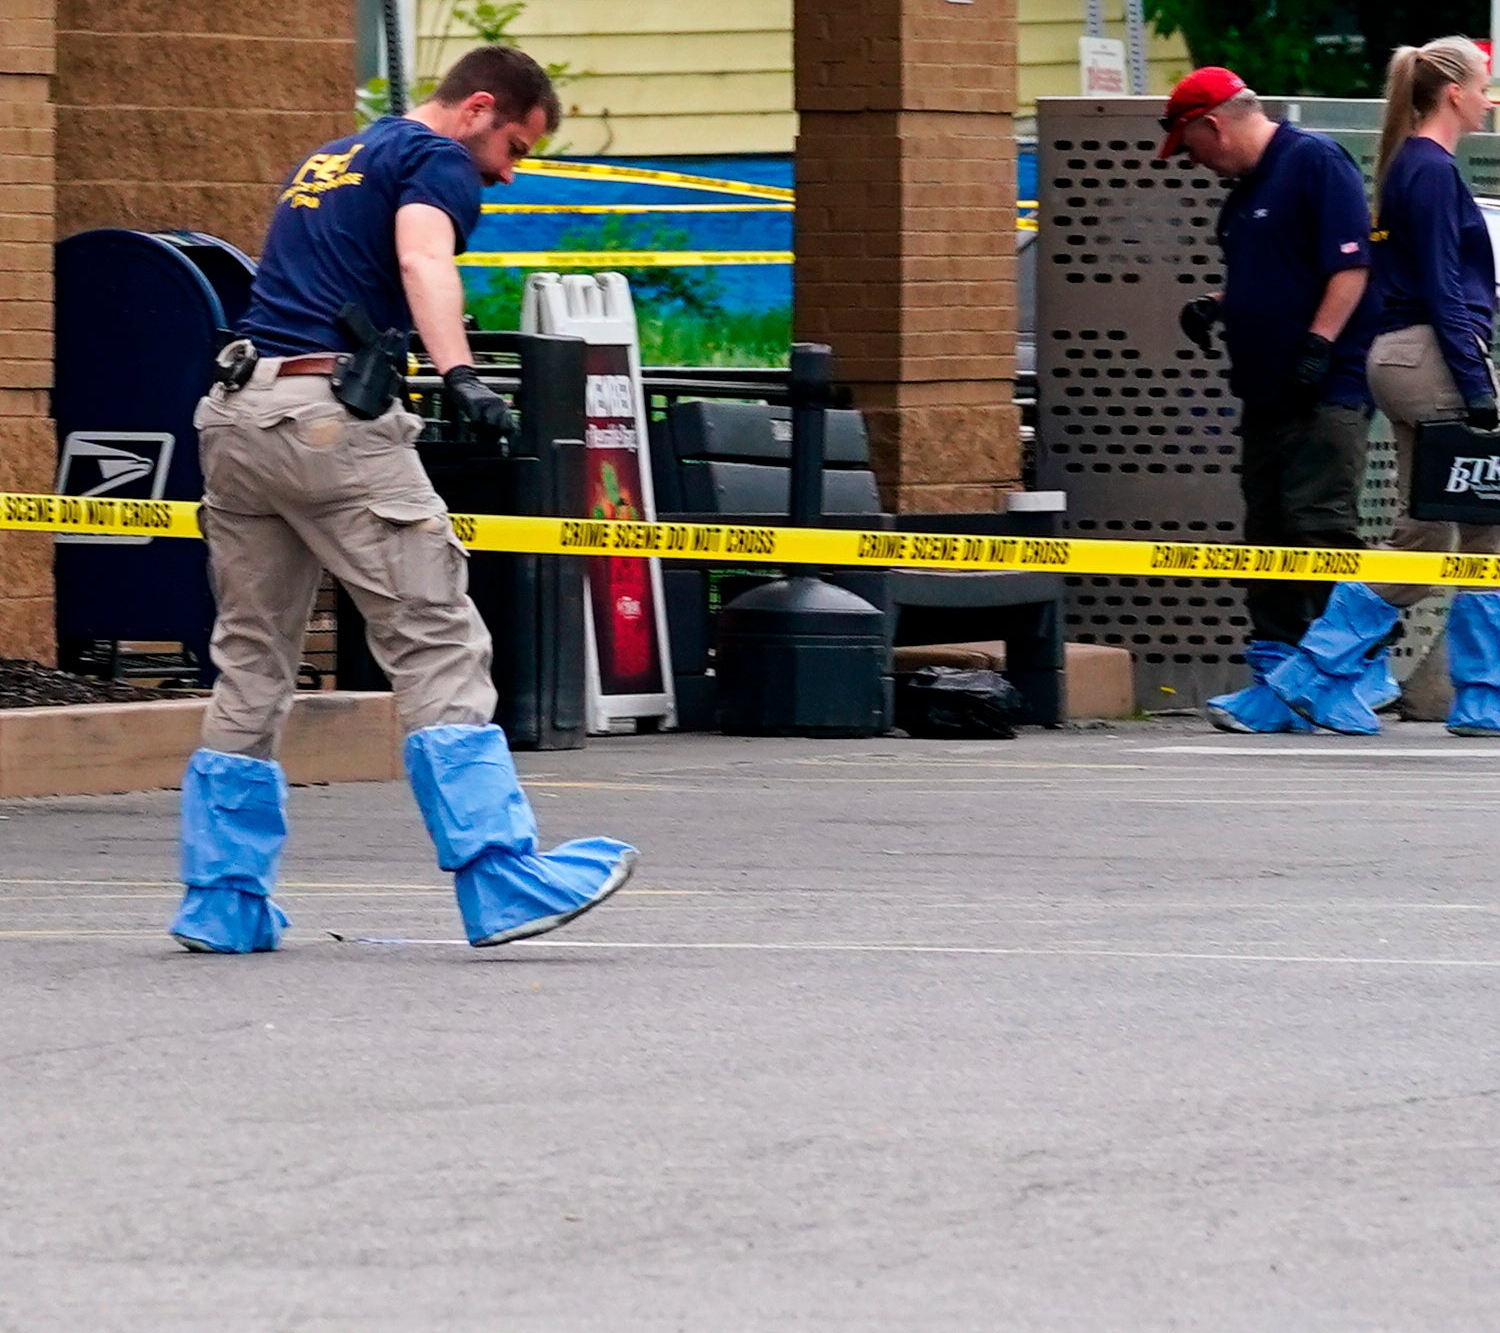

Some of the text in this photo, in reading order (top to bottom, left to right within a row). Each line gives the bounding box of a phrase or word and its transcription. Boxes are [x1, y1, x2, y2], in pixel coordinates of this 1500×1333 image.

[560, 521, 776, 554] CRIME SCENE DO NOT CROSS
[857, 533, 1072, 565] CRIME SCENE DO NOT CROSS
[1149, 544, 1363, 575] CRIME SCENE DO NOT CROSS
[1440, 555, 1490, 580] CRIME
